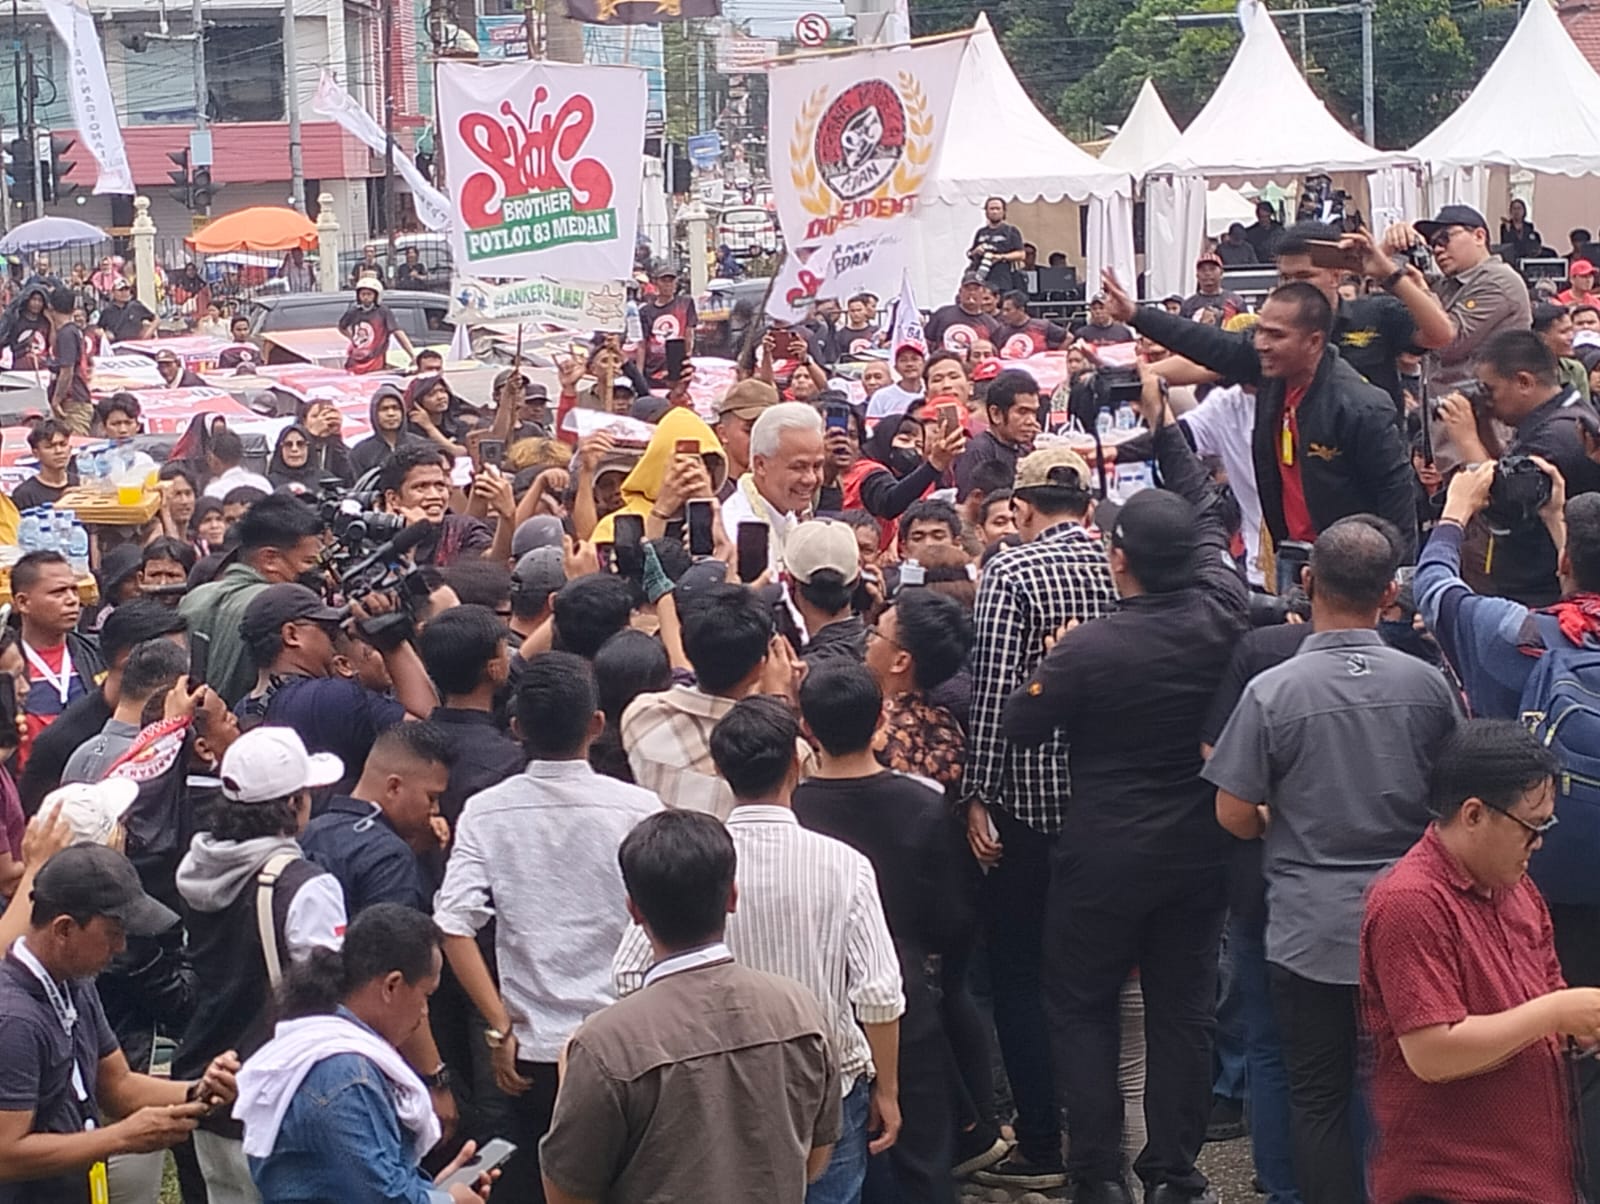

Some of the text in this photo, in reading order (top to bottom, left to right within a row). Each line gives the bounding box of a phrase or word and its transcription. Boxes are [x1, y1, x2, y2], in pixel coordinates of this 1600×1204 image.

[503, 191, 571, 222] BROTHER
[470, 214, 611, 254] POTLOT 83 MEDAN
[835, 249, 873, 274] EDAN
